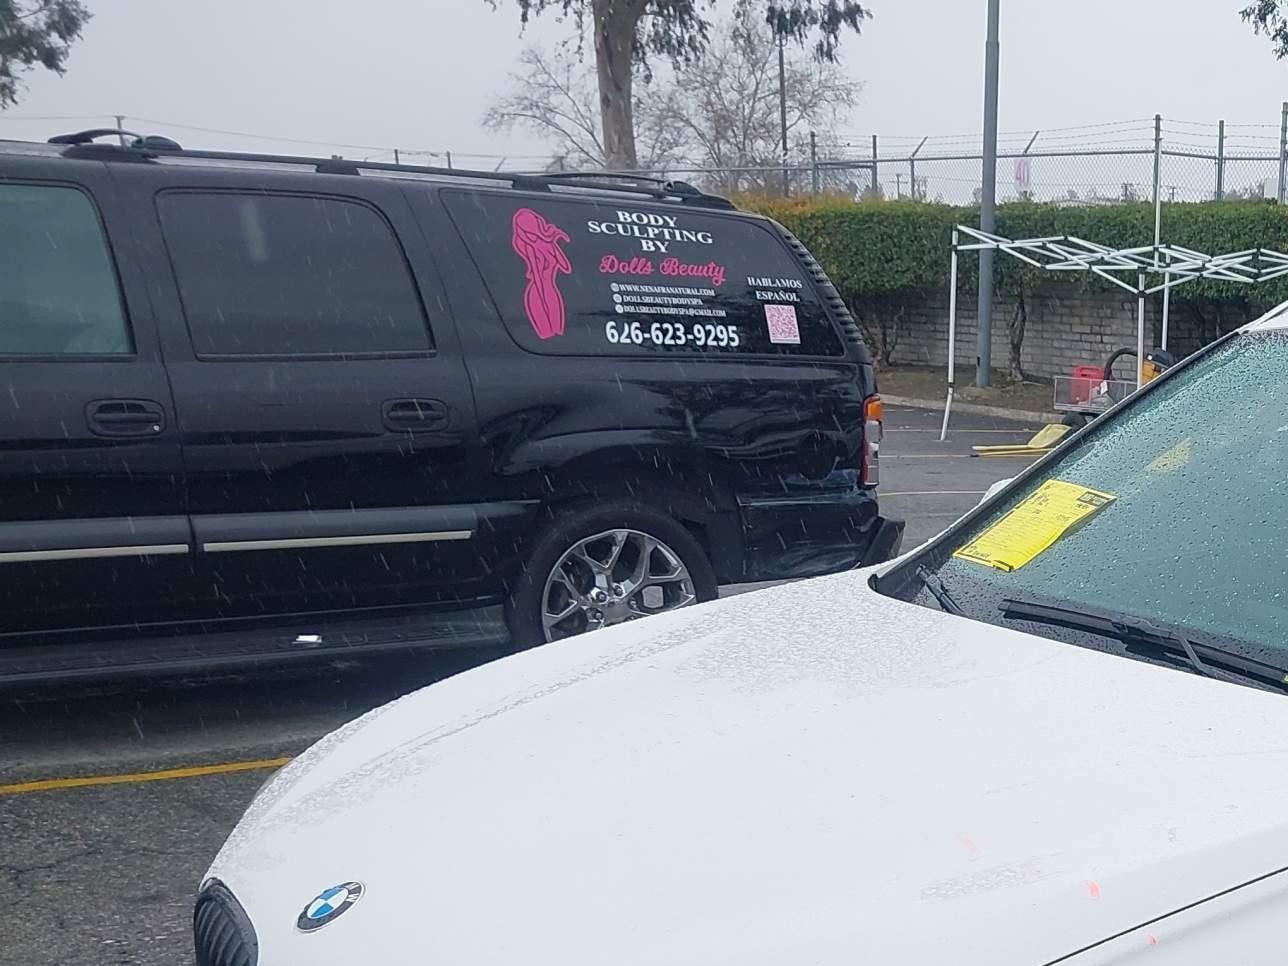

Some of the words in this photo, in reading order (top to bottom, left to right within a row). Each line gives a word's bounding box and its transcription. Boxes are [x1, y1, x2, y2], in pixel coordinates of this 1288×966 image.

[616, 211, 677, 227] BODY
[588, 221, 713, 244] SCULPTING
[640, 239, 669, 253] BY
[599, 255, 654, 275] Dolls
[659, 258, 726, 286] Beauty
[747, 276, 803, 289] HABLAMOS
[755, 290, 800, 302] ESPAÑOL
[605, 321, 740, 347] 626-623-9295
